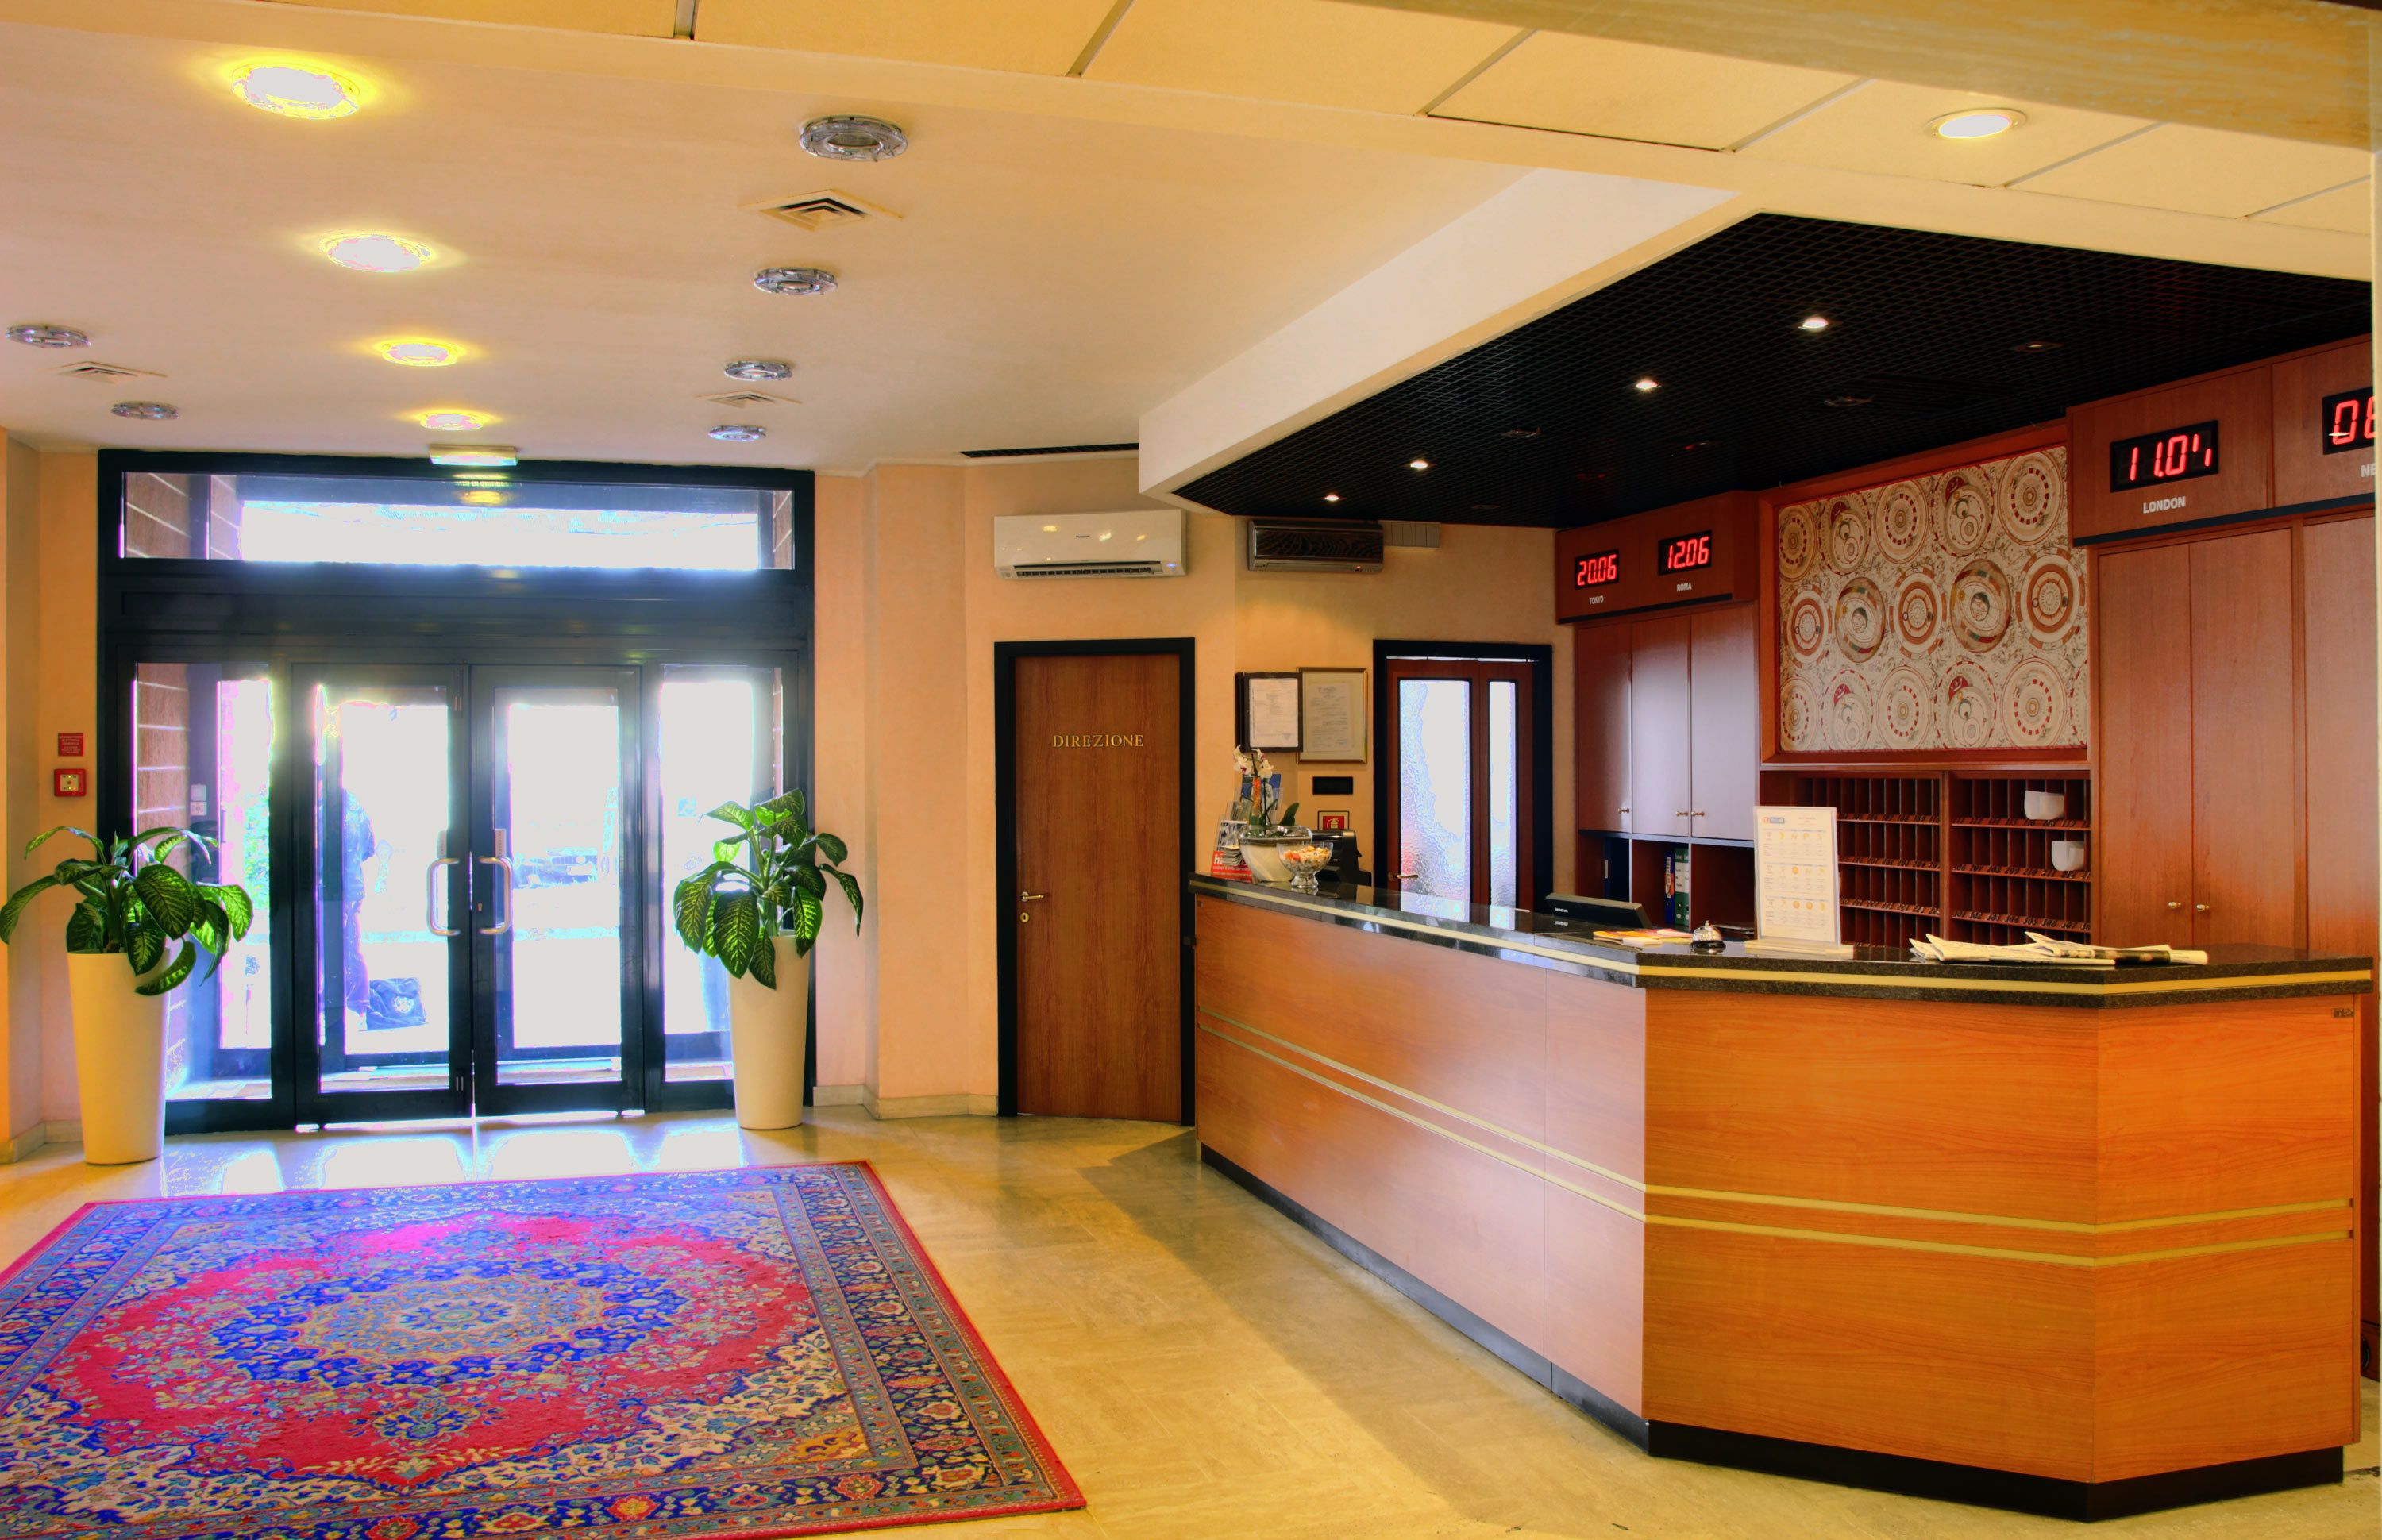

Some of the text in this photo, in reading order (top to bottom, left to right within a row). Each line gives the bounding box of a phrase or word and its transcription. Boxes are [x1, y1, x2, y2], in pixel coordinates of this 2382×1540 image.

[2143, 496, 2186, 514] LONDON
[1676, 582, 1692, 591] ROMA
[1589, 595, 1604, 604] TOKYO
[1053, 734, 1143, 747] DIREZIONE
